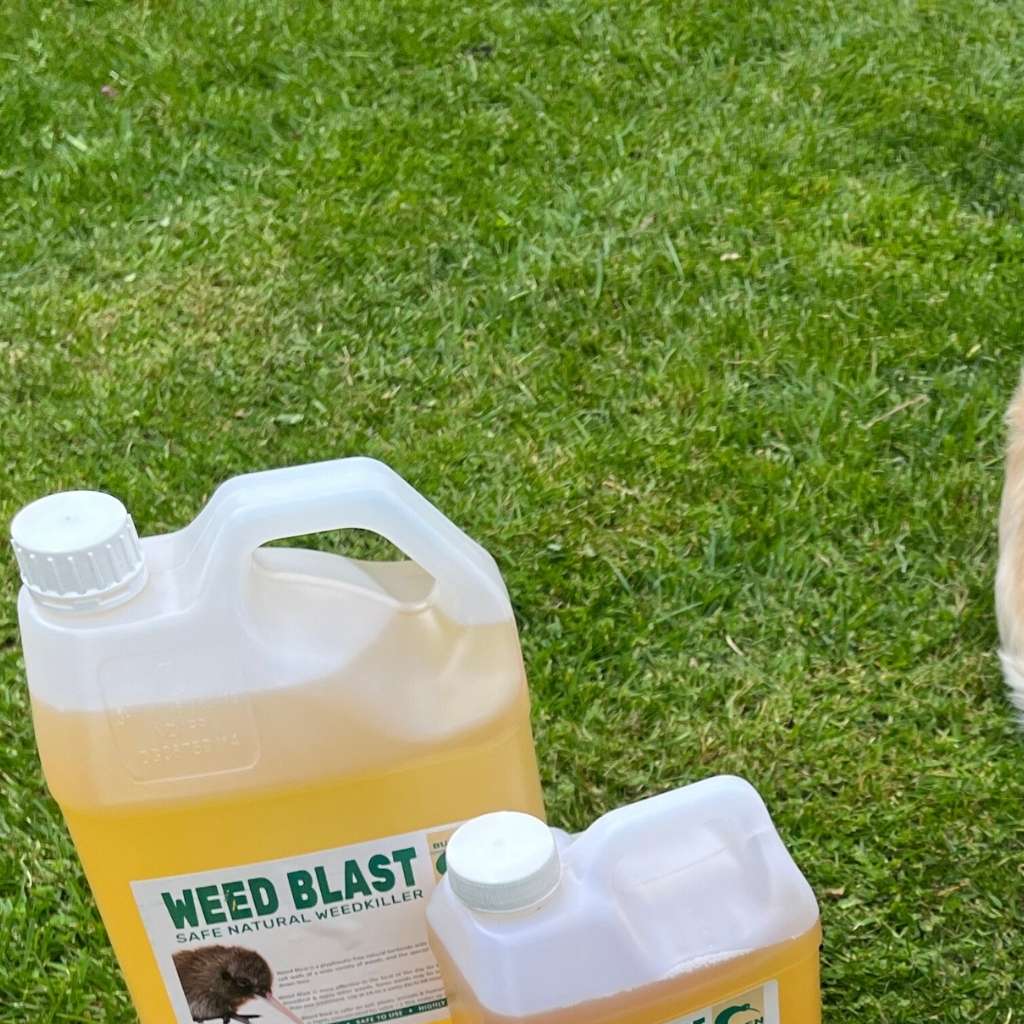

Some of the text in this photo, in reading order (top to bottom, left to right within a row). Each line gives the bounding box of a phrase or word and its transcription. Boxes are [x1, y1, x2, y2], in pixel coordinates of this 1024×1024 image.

[161, 847, 417, 929] WEED BLAST
[176, 889, 424, 943] SAFE NATURAL WEEDKILLER
